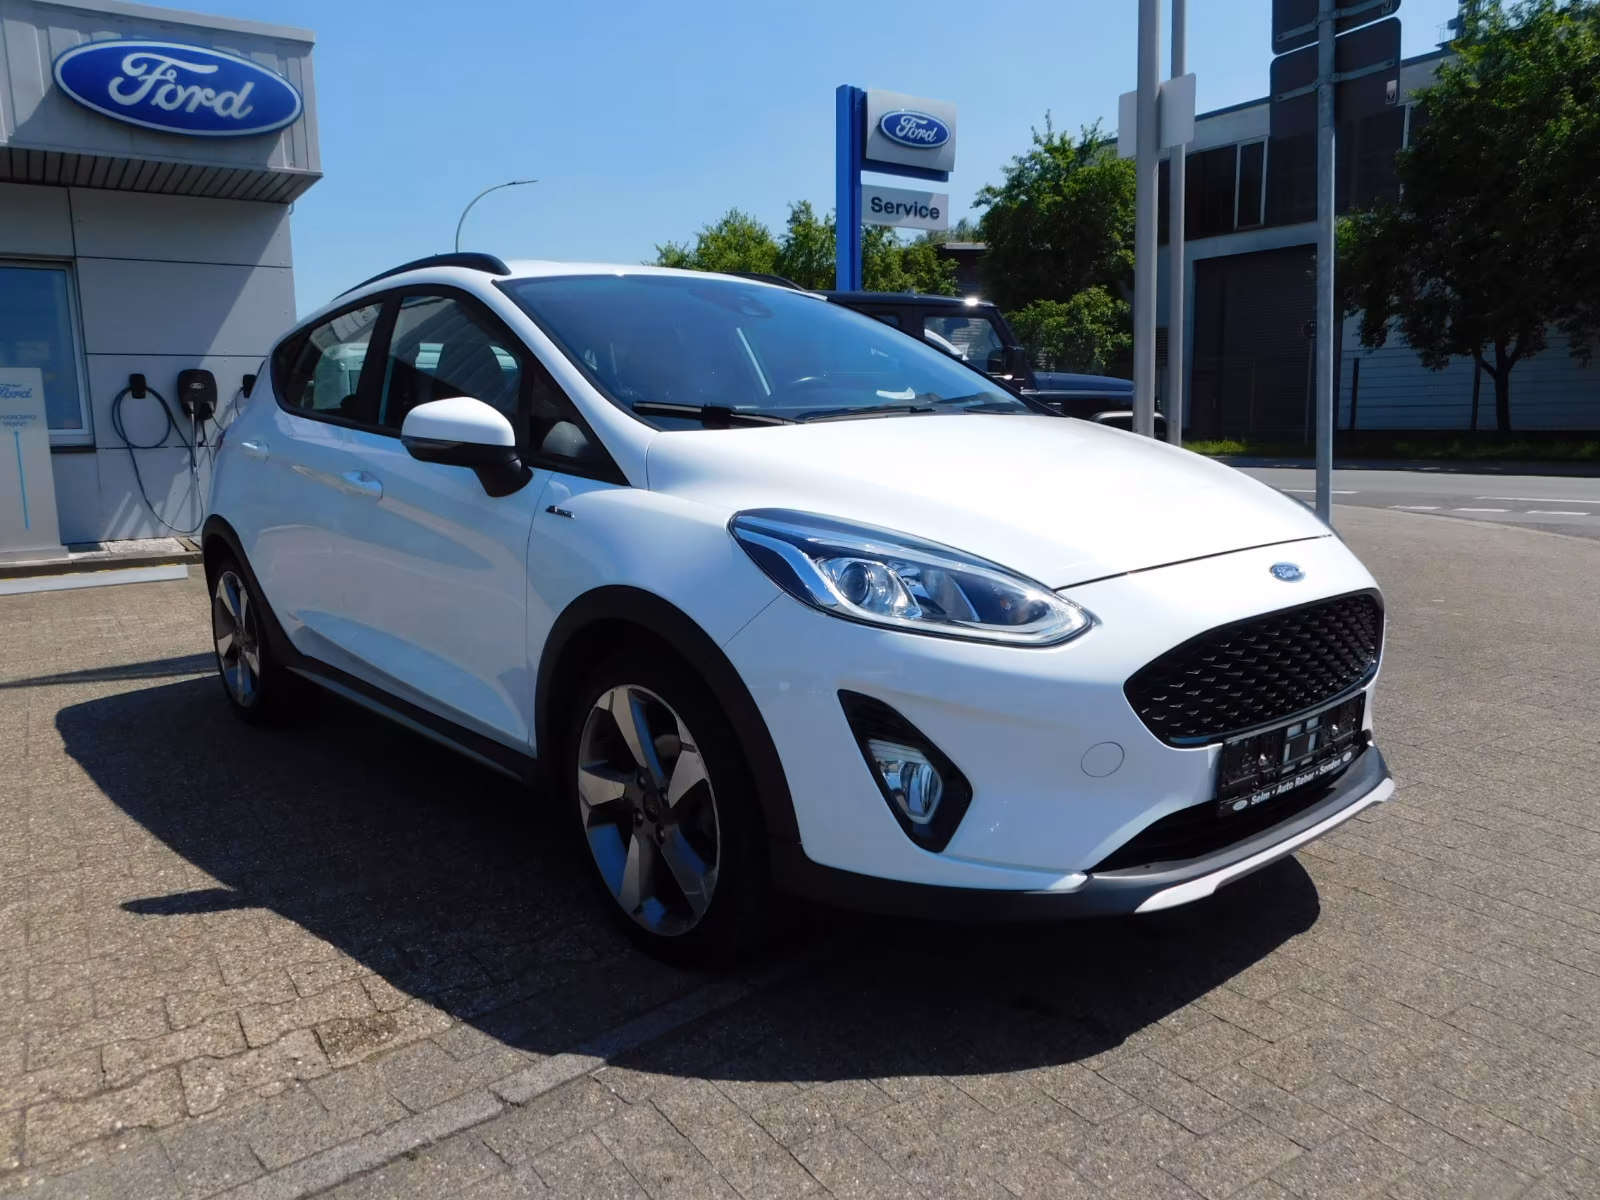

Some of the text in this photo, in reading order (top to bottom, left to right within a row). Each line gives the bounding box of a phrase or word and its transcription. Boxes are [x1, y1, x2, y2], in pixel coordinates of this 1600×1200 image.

[108, 52, 255, 119] Ford
[896, 115, 938, 142] Ford
[871, 197, 940, 220] Service
[1277, 780, 1294, 795] Auto
